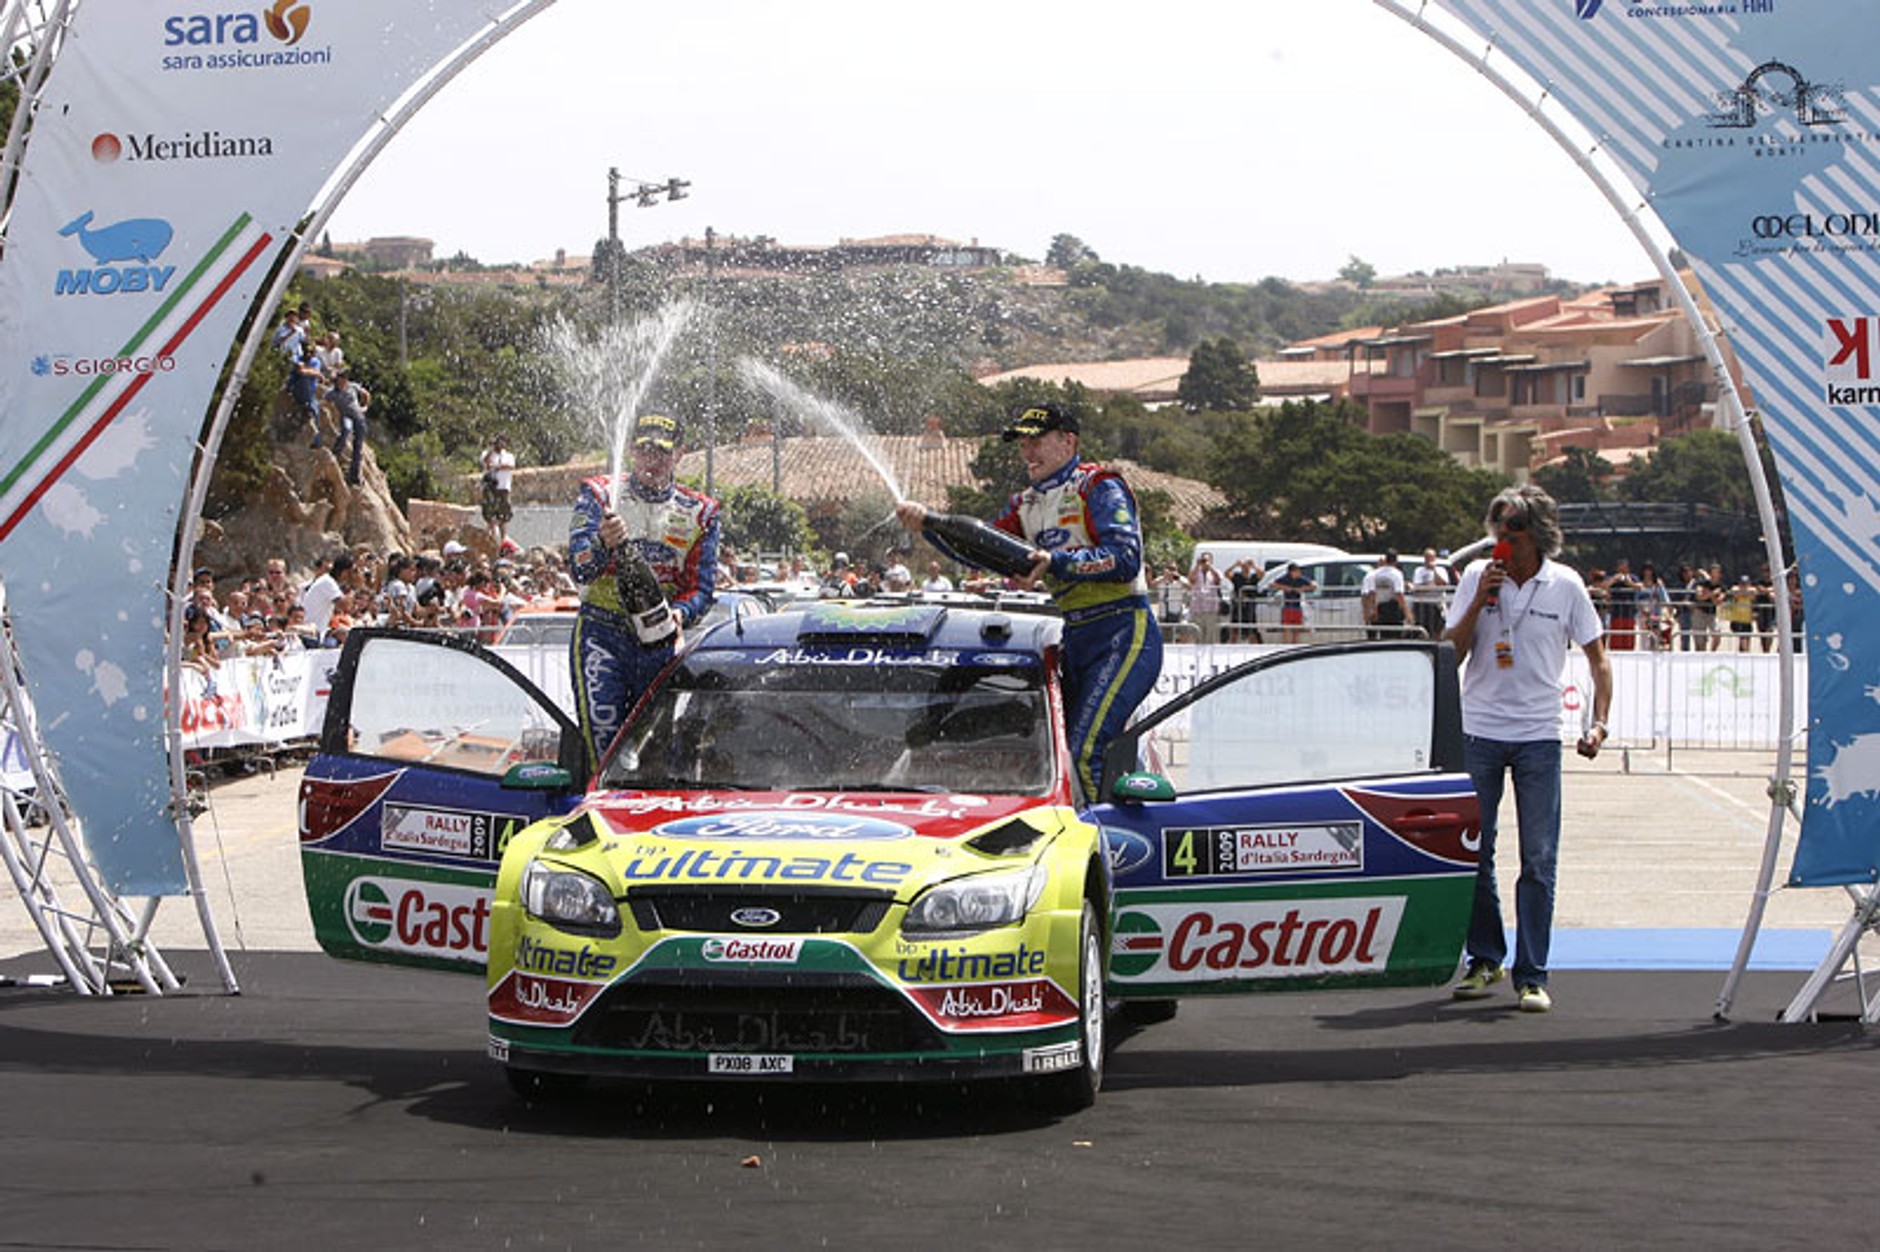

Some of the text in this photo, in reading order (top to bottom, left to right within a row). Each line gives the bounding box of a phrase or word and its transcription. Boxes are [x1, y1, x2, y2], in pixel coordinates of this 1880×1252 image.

[1627, 6, 1736, 18] CONCESSIONARIA
[164, 13, 258, 46] sara
[162, 46, 331, 70] sara assicurazioni
[127, 132, 273, 161] Meridiana
[55, 266, 177, 295] MOBY
[755, 650, 843, 664] Abu
[848, 649, 960, 665] Dhabi
[629, 794, 967, 818] Abu Dhabi
[426, 814, 469, 833] RALLY
[474, 817, 486, 856] 2009
[697, 816, 866, 838] Ford
[1173, 831, 1197, 875] 4
[1219, 831, 1235, 872] 2009
[1240, 832, 1299, 849] RALLY
[625, 850, 913, 883] ultimate
[1241, 847, 1356, 865] d'Italia Sardegna
[727, 939, 794, 960] Castrol
[1168, 906, 1383, 971] Castrol
[899, 943, 1045, 982] ultimate
[937, 983, 1044, 1017] Abu Dhabi
[715, 1056, 787, 1072] PX08 AXC
